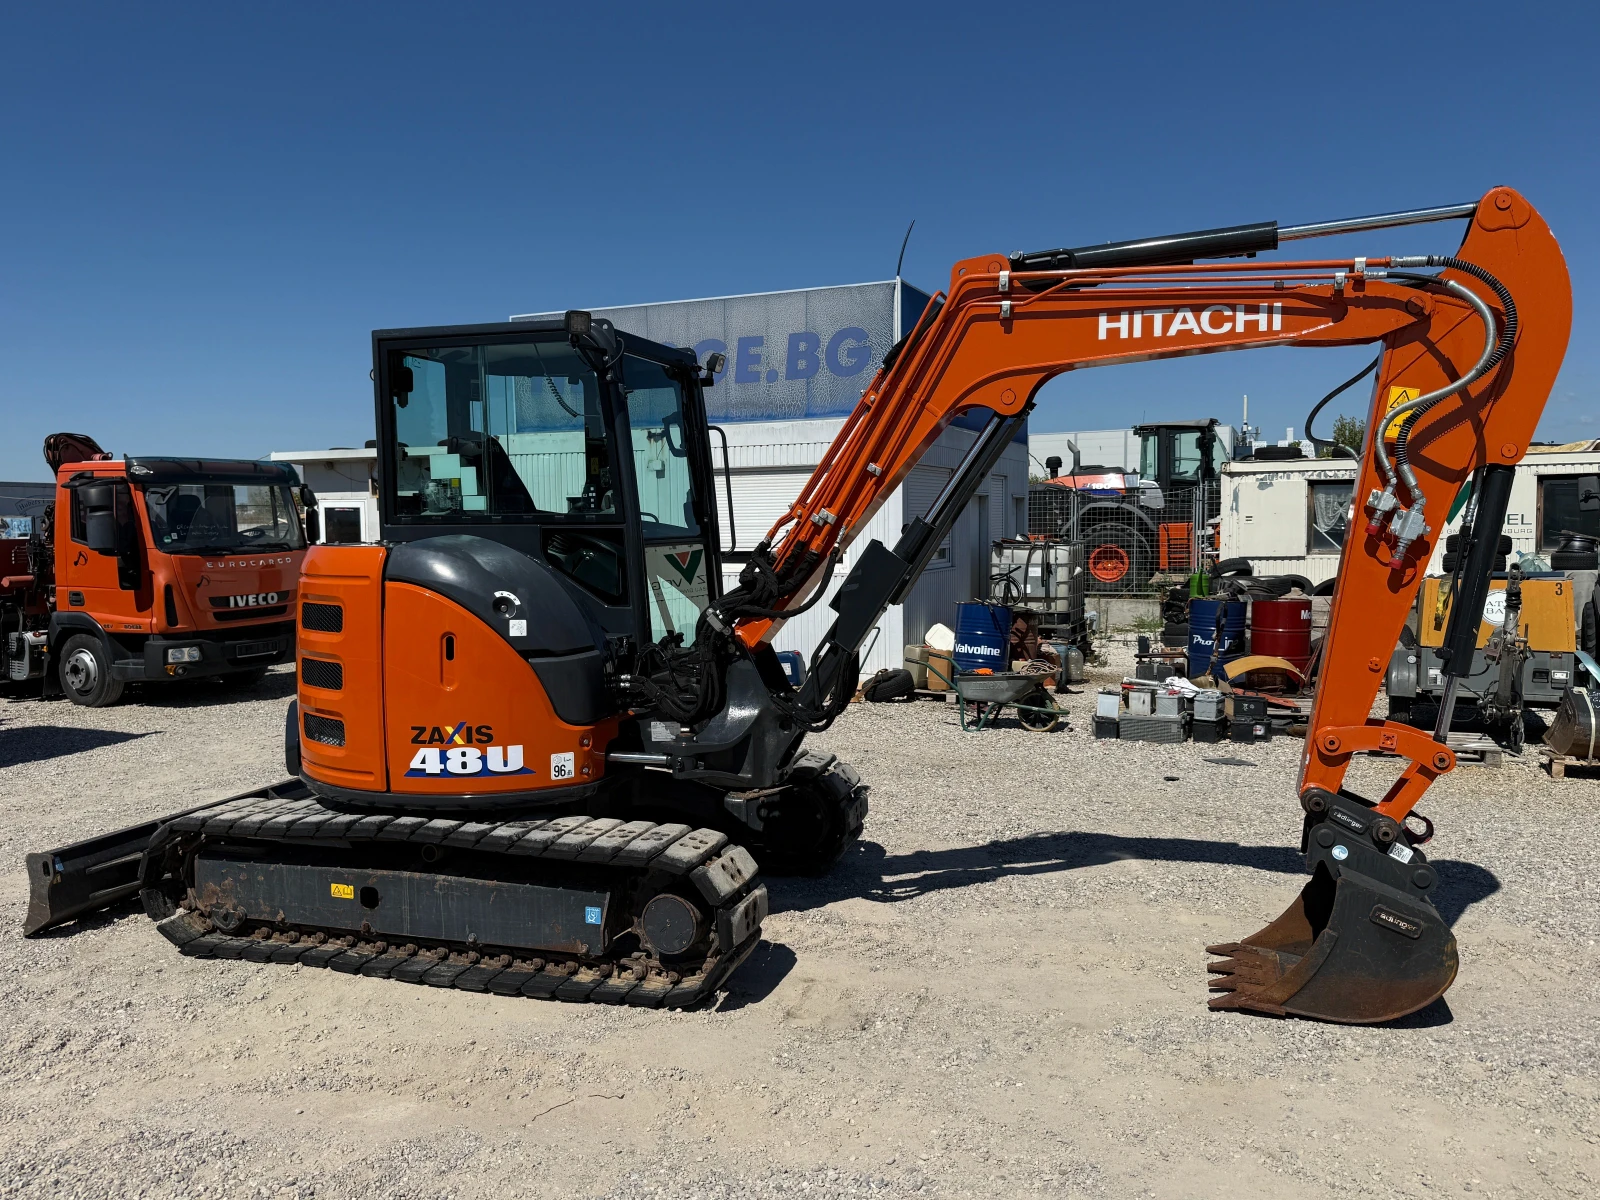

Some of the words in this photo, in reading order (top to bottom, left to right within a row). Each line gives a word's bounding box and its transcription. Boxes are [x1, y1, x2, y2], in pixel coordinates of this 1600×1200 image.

[1098, 302, 1282, 340] HITACHI
[692, 326, 872, 386] GE.BG
[206, 557, 292, 568] EUROCARGO
[1555, 582, 1563, 596] 3
[229, 592, 278, 608] IVECO
[1486, 607, 1504, 615] BA
[954, 643, 1001, 657] Valvoline
[410, 721, 494, 745] ZAXIS
[409, 744, 524, 775] 48U
[553, 763, 567, 778] 96
